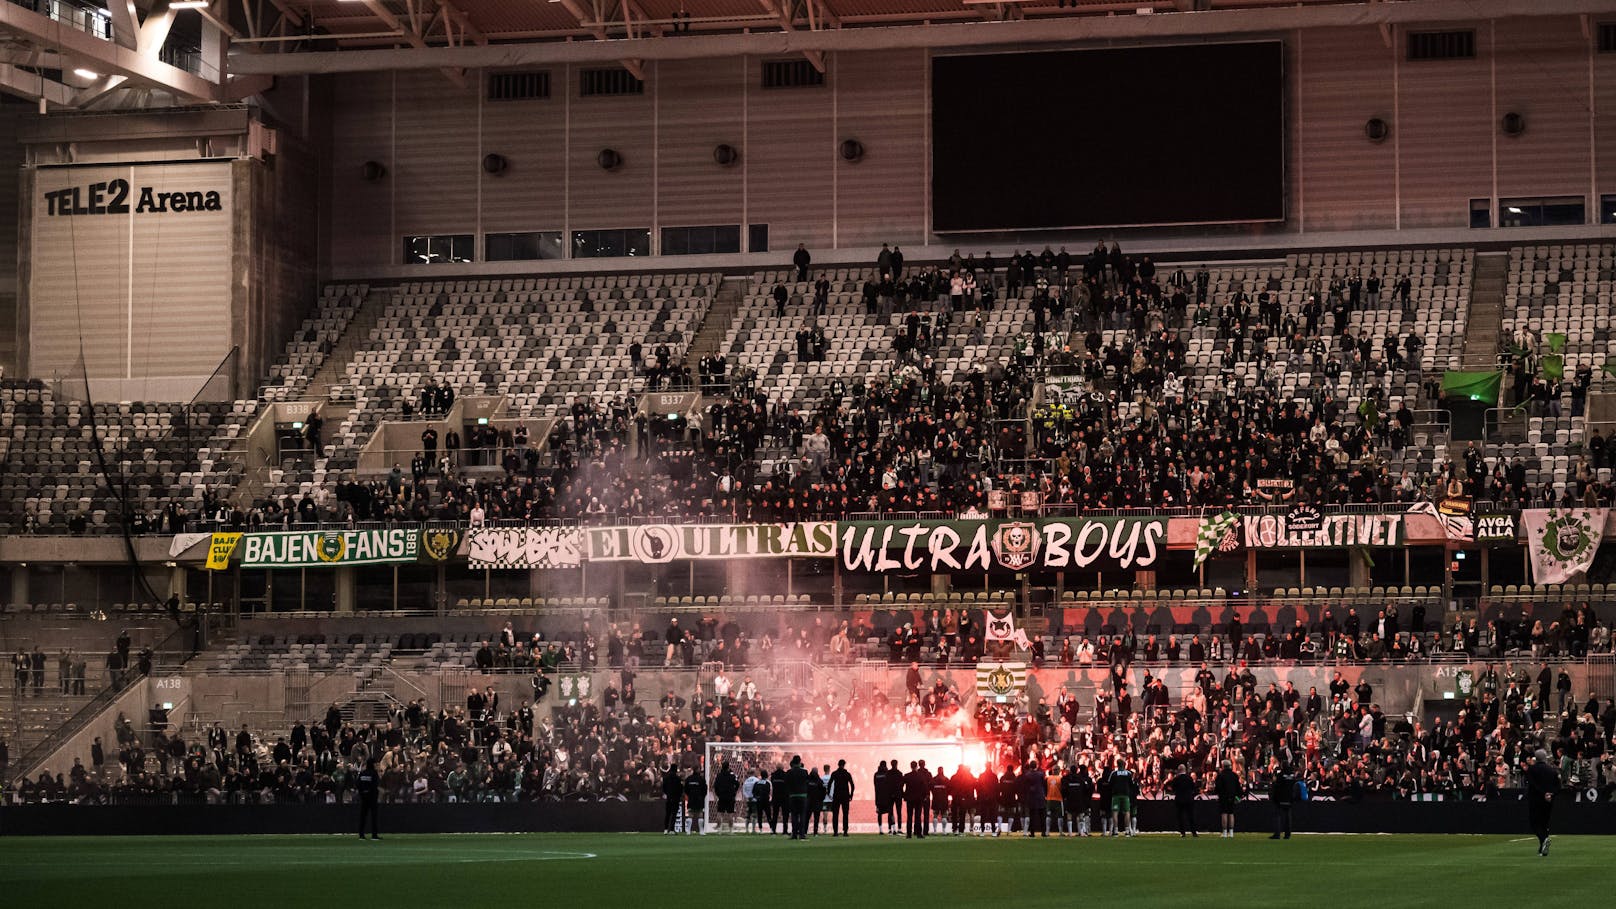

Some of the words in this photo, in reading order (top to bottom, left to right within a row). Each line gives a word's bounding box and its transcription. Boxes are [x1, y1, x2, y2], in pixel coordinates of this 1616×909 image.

[44, 178, 130, 216] TELE2
[136, 187, 222, 213] Arena
[661, 395, 684, 405] B337
[1288, 506, 1321, 519] DEFEND
[1478, 515, 1514, 528] AVGÅ
[406, 528, 417, 556] 1981
[682, 524, 833, 555] ULTRAS
[1478, 527, 1514, 538] ALLA
[244, 534, 319, 563] BAJEN
[343, 529, 405, 560] FANS
[842, 523, 992, 573] ULTRA
[1043, 519, 1163, 570] BOYS
[157, 679, 181, 689] A138
